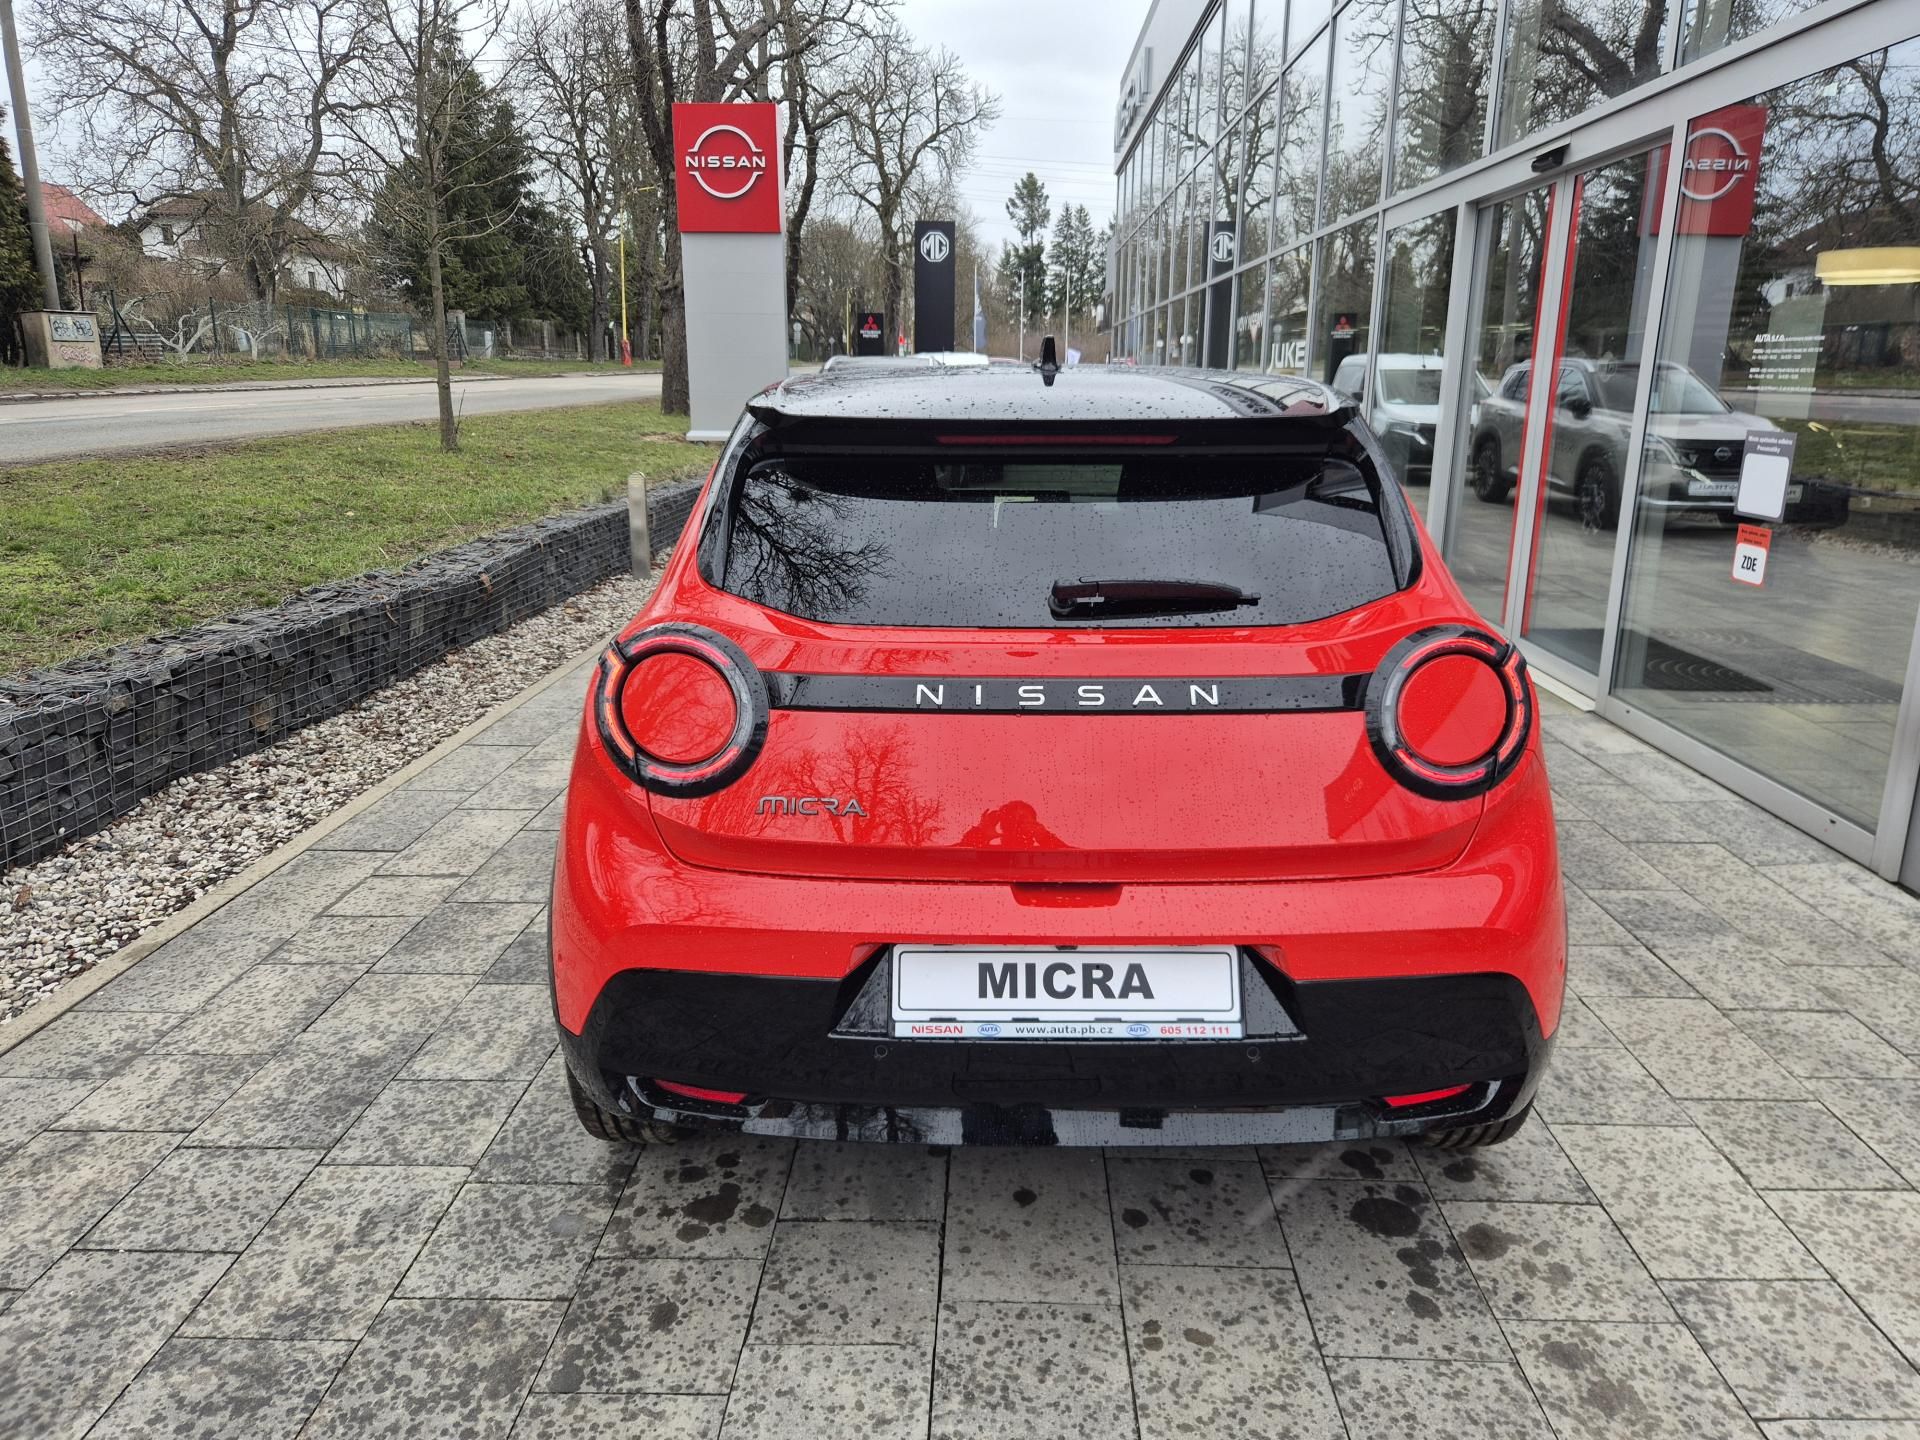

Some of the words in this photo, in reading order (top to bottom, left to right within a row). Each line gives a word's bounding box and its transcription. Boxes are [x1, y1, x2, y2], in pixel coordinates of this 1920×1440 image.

[685, 155, 766, 168] NISSAN
[922, 232, 948, 261] MG
[1266, 340, 1306, 375] JUKE
[1741, 555, 1758, 572] ZDE
[915, 684, 1220, 706] NISSAN
[755, 796, 868, 817] MICRA
[977, 962, 1155, 1000] MICRA
[911, 1025, 963, 1034] NISSAN
[980, 1025, 998, 1033] AUTA
[1015, 1025, 1114, 1036] www.auta.pb.cz
[1129, 1025, 1147, 1033] AUTA
[1160, 1026, 1182, 1035] 605
[1187, 1026, 1207, 1035] 112
[1212, 1026, 1230, 1035] 111
